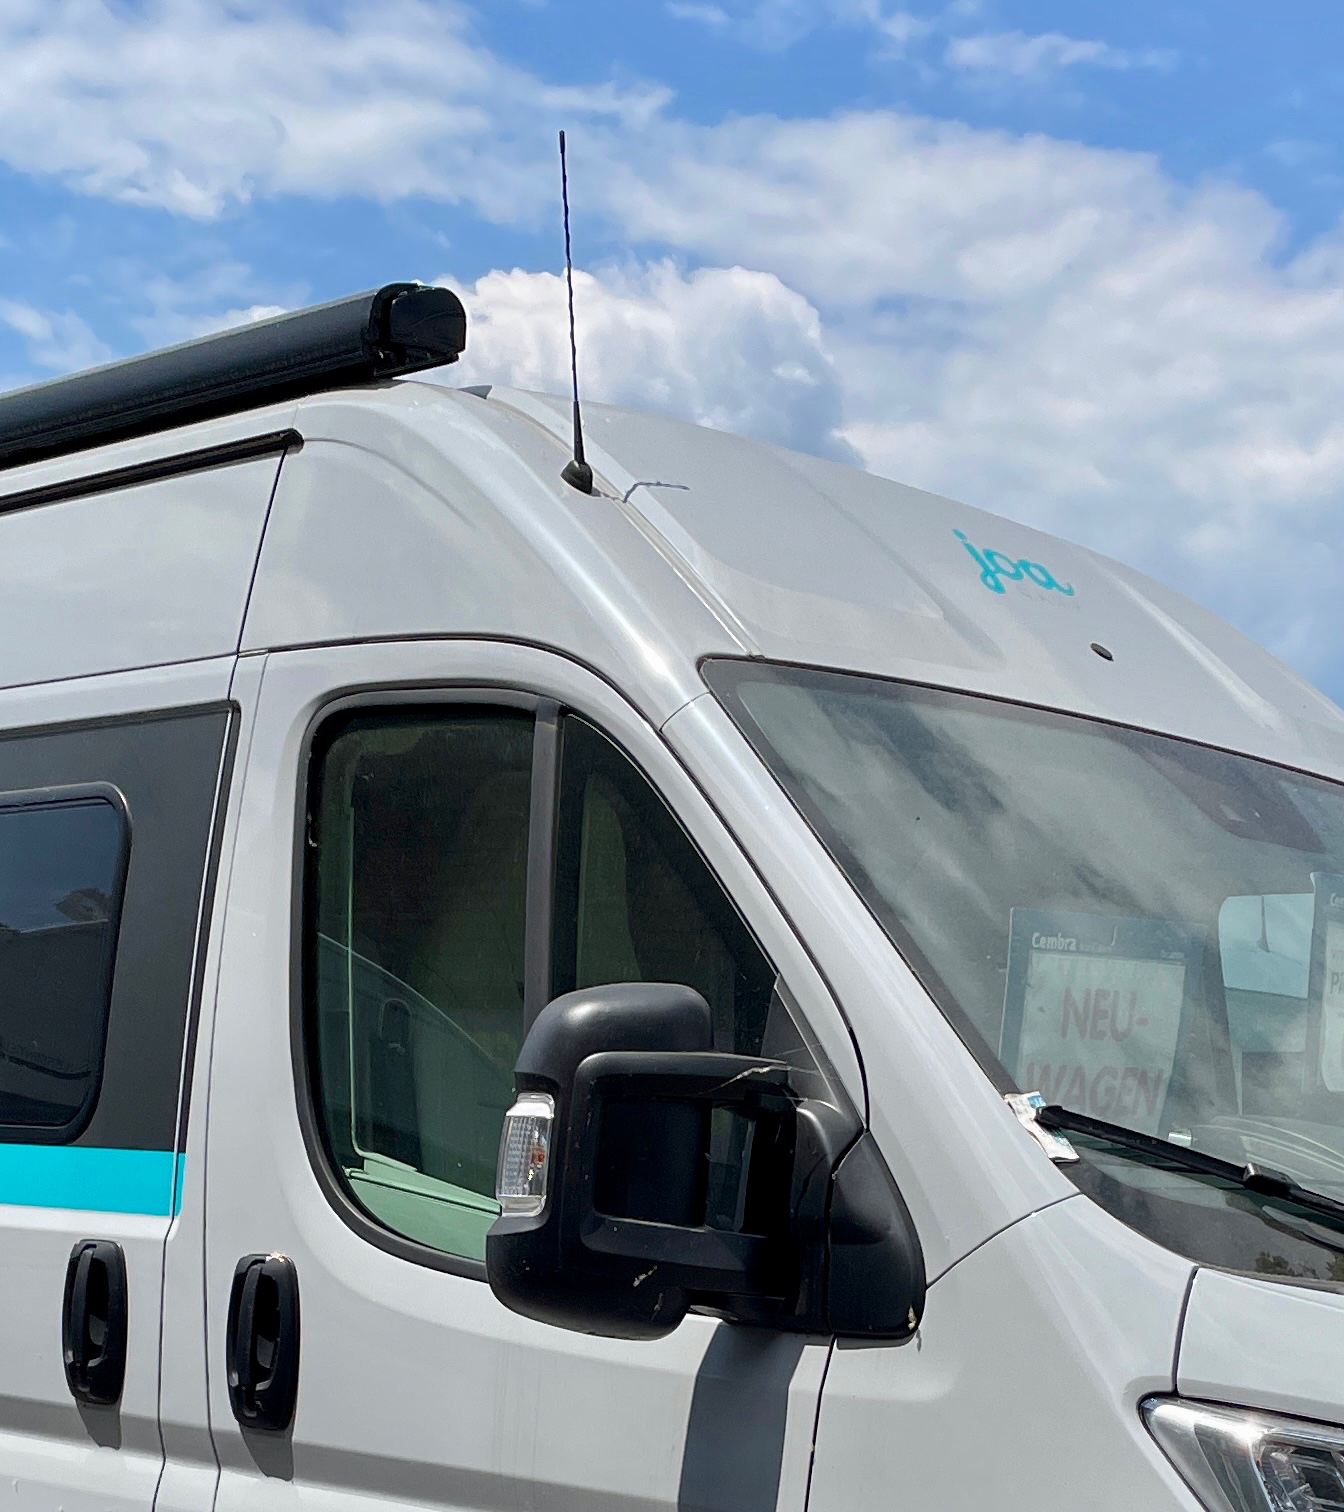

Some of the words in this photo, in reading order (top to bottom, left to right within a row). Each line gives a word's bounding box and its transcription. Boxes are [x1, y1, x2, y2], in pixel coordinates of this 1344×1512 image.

[952, 529, 1074, 596] joa
[1032, 932, 1077, 951] Cembra
[1060, 986, 1149, 1042] NEU-
[1025, 1061, 1164, 1116] WAGEN
